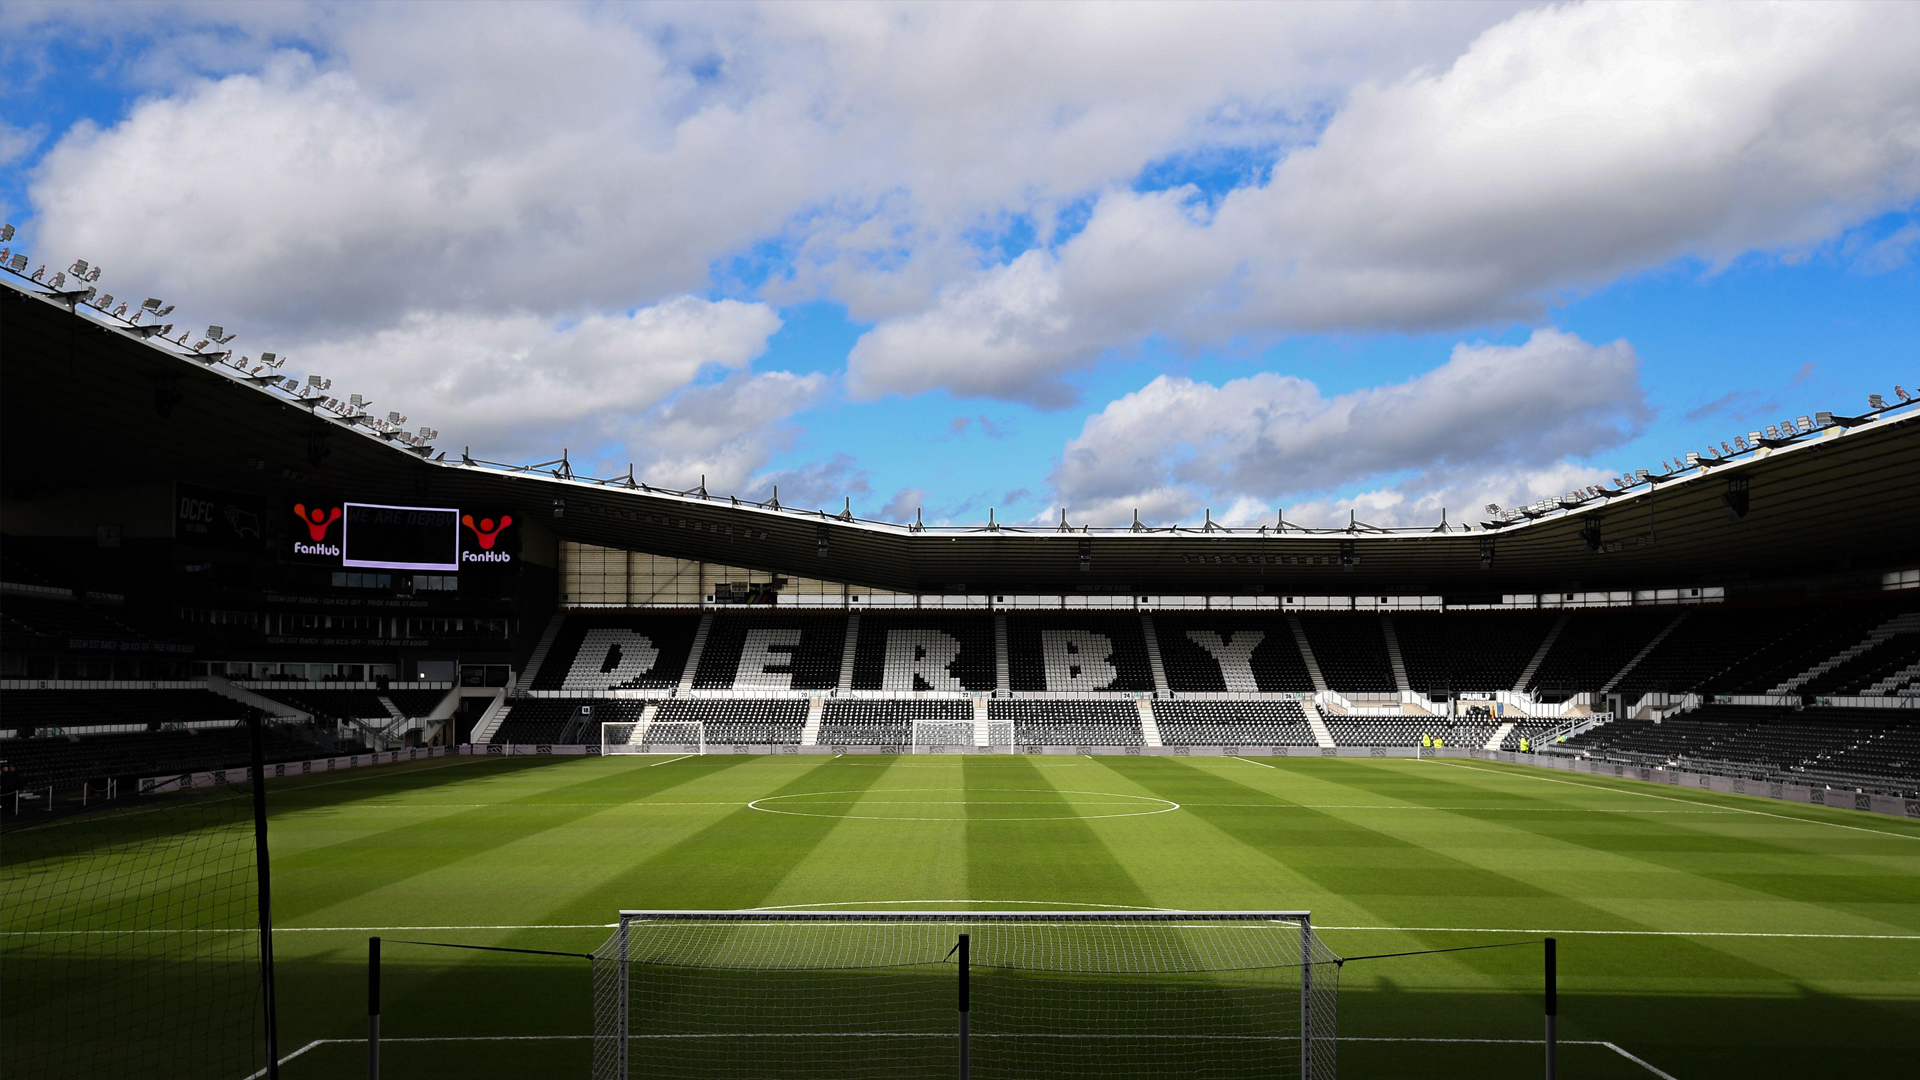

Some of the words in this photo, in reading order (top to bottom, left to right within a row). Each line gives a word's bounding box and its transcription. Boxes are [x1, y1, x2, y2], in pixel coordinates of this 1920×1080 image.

[179, 497, 215, 523] DCFC
[348, 508, 369, 522] WE
[374, 510, 402, 525] ARE
[407, 512, 454, 527] DERBY
[294, 541, 341, 557] FanHub
[462, 551, 511, 563] FanHub
[560, 628, 1265, 692] DERBY
